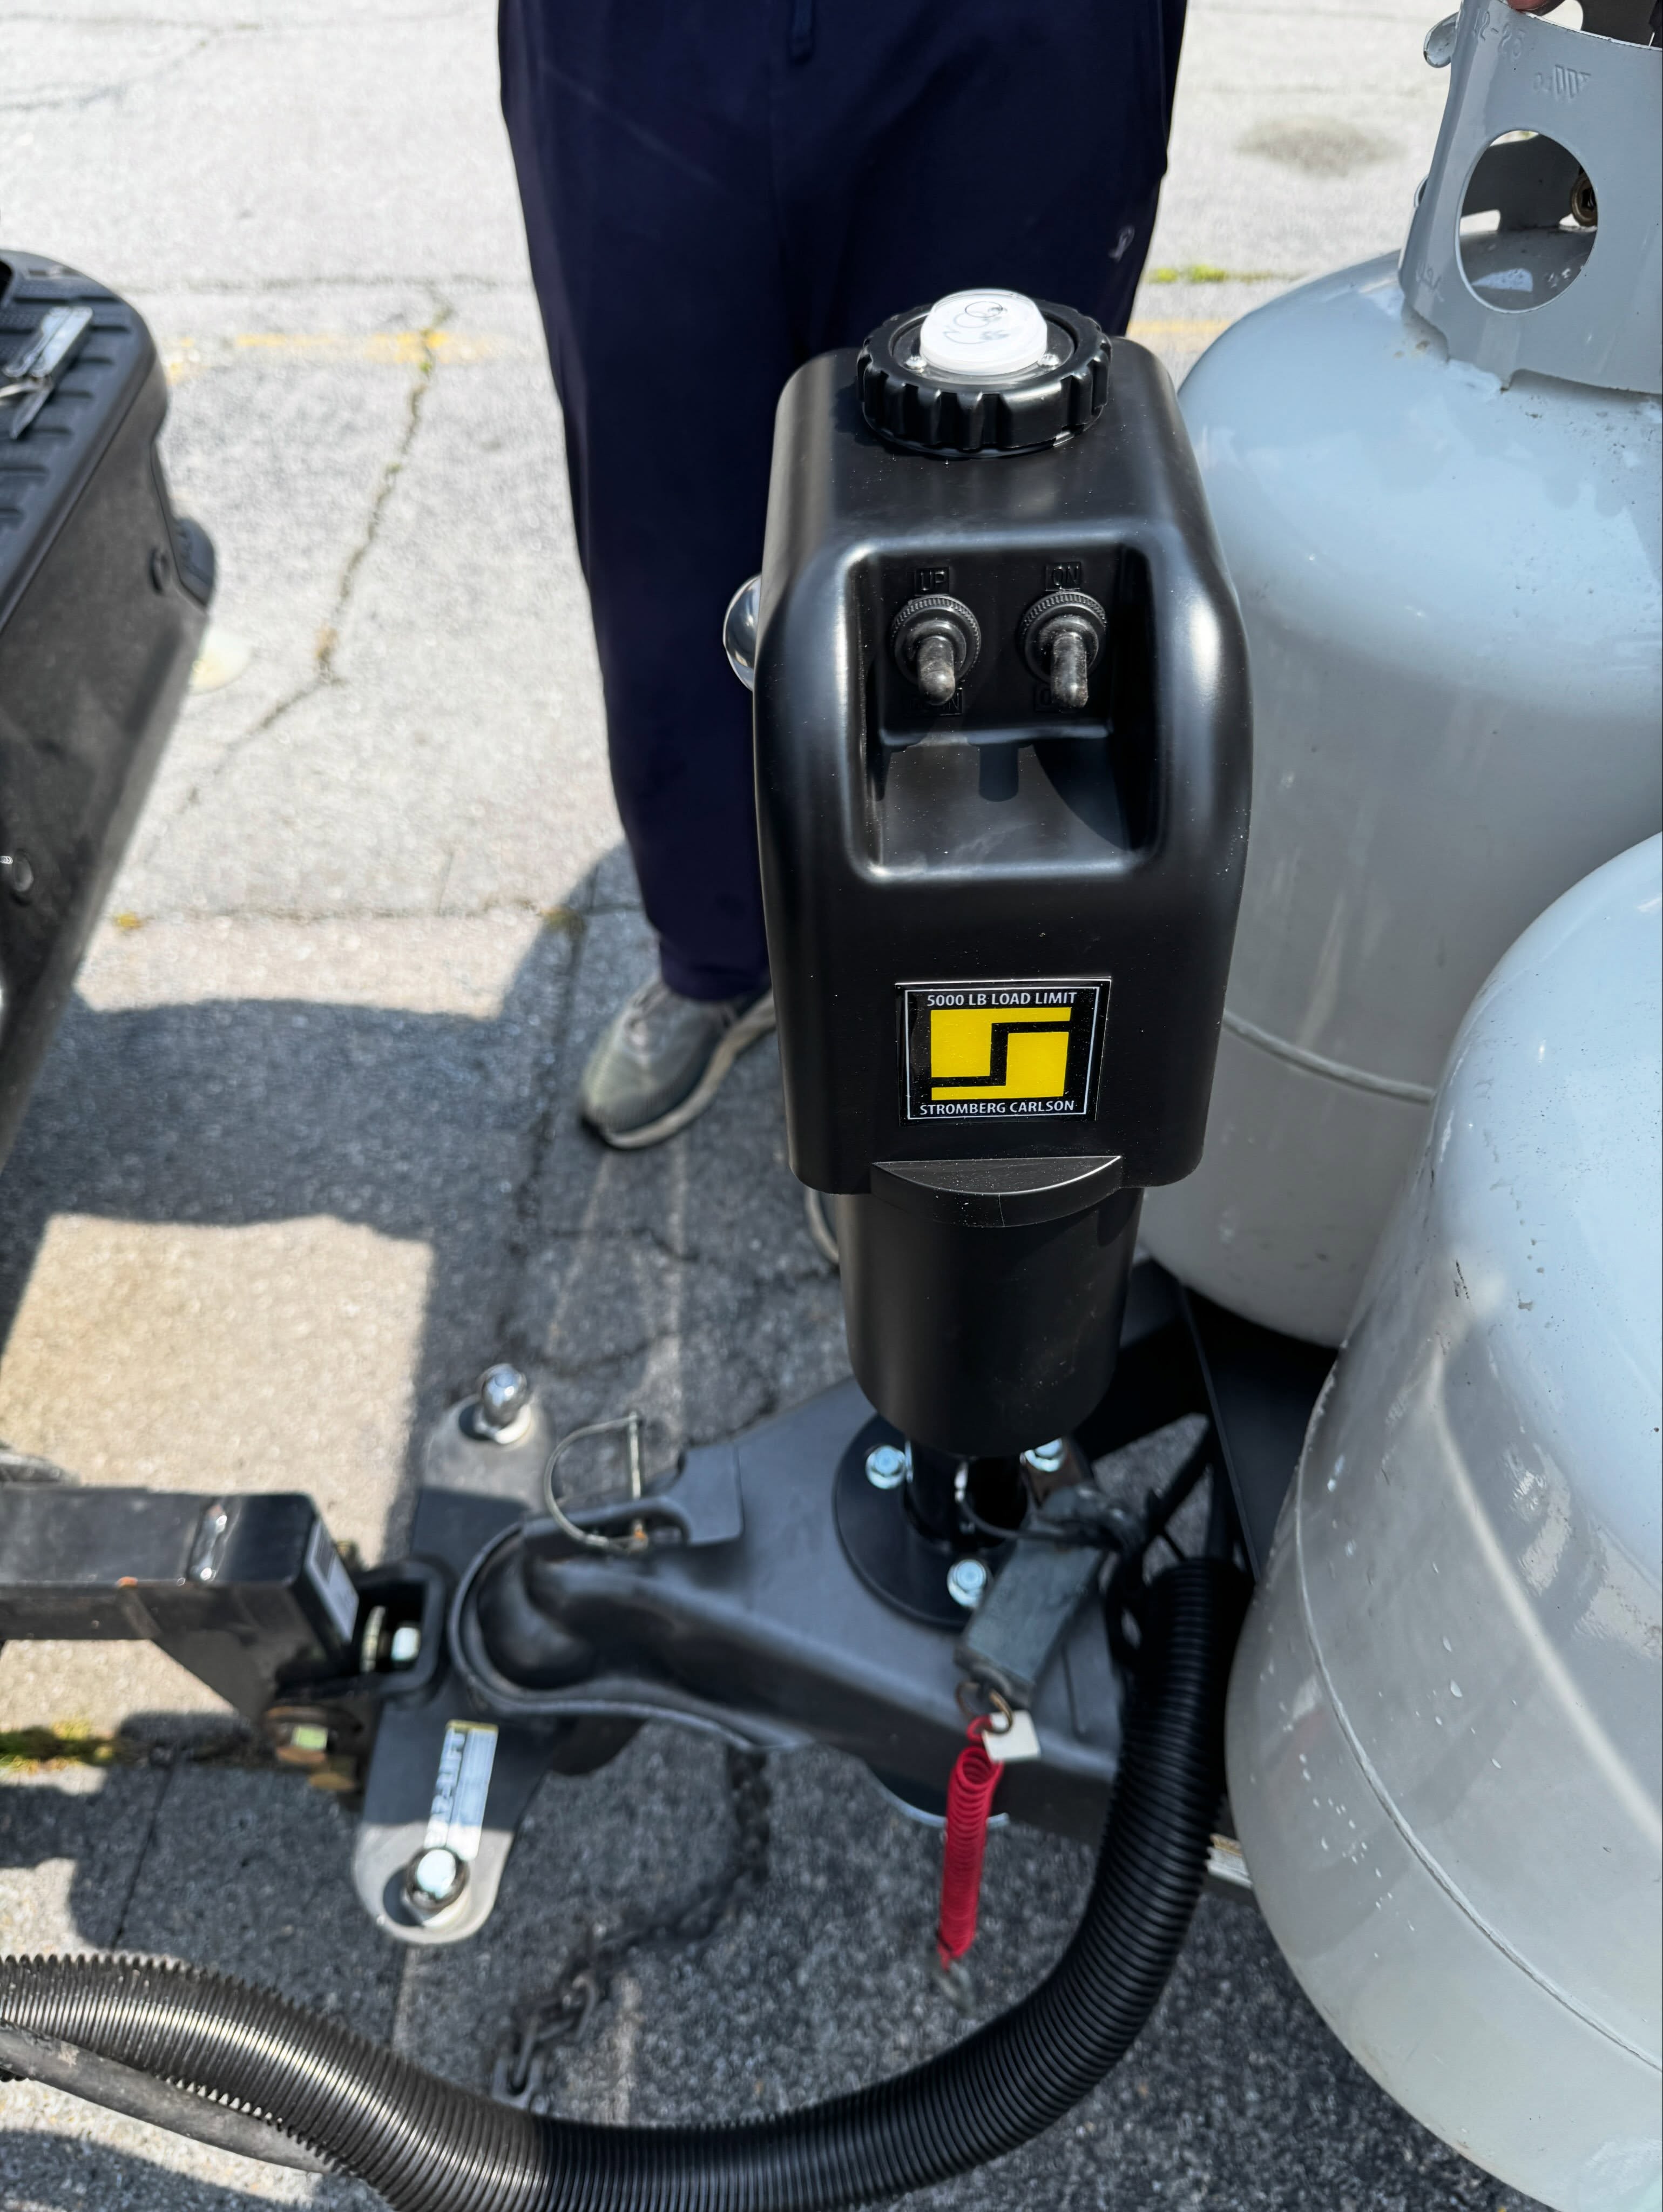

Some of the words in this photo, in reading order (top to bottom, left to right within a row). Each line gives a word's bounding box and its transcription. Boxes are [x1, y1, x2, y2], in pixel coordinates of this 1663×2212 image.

[920, 570, 946, 591] UP
[1051, 564, 1079, 586] ON
[927, 994, 964, 1007] 5000
[969, 994, 987, 1006] LB
[991, 993, 1031, 1005] LOAD
[1035, 992, 1077, 1004] LIMIT
[920, 1102, 1006, 1115] STROMBERG
[1010, 1100, 1074, 1112] CARLSON
